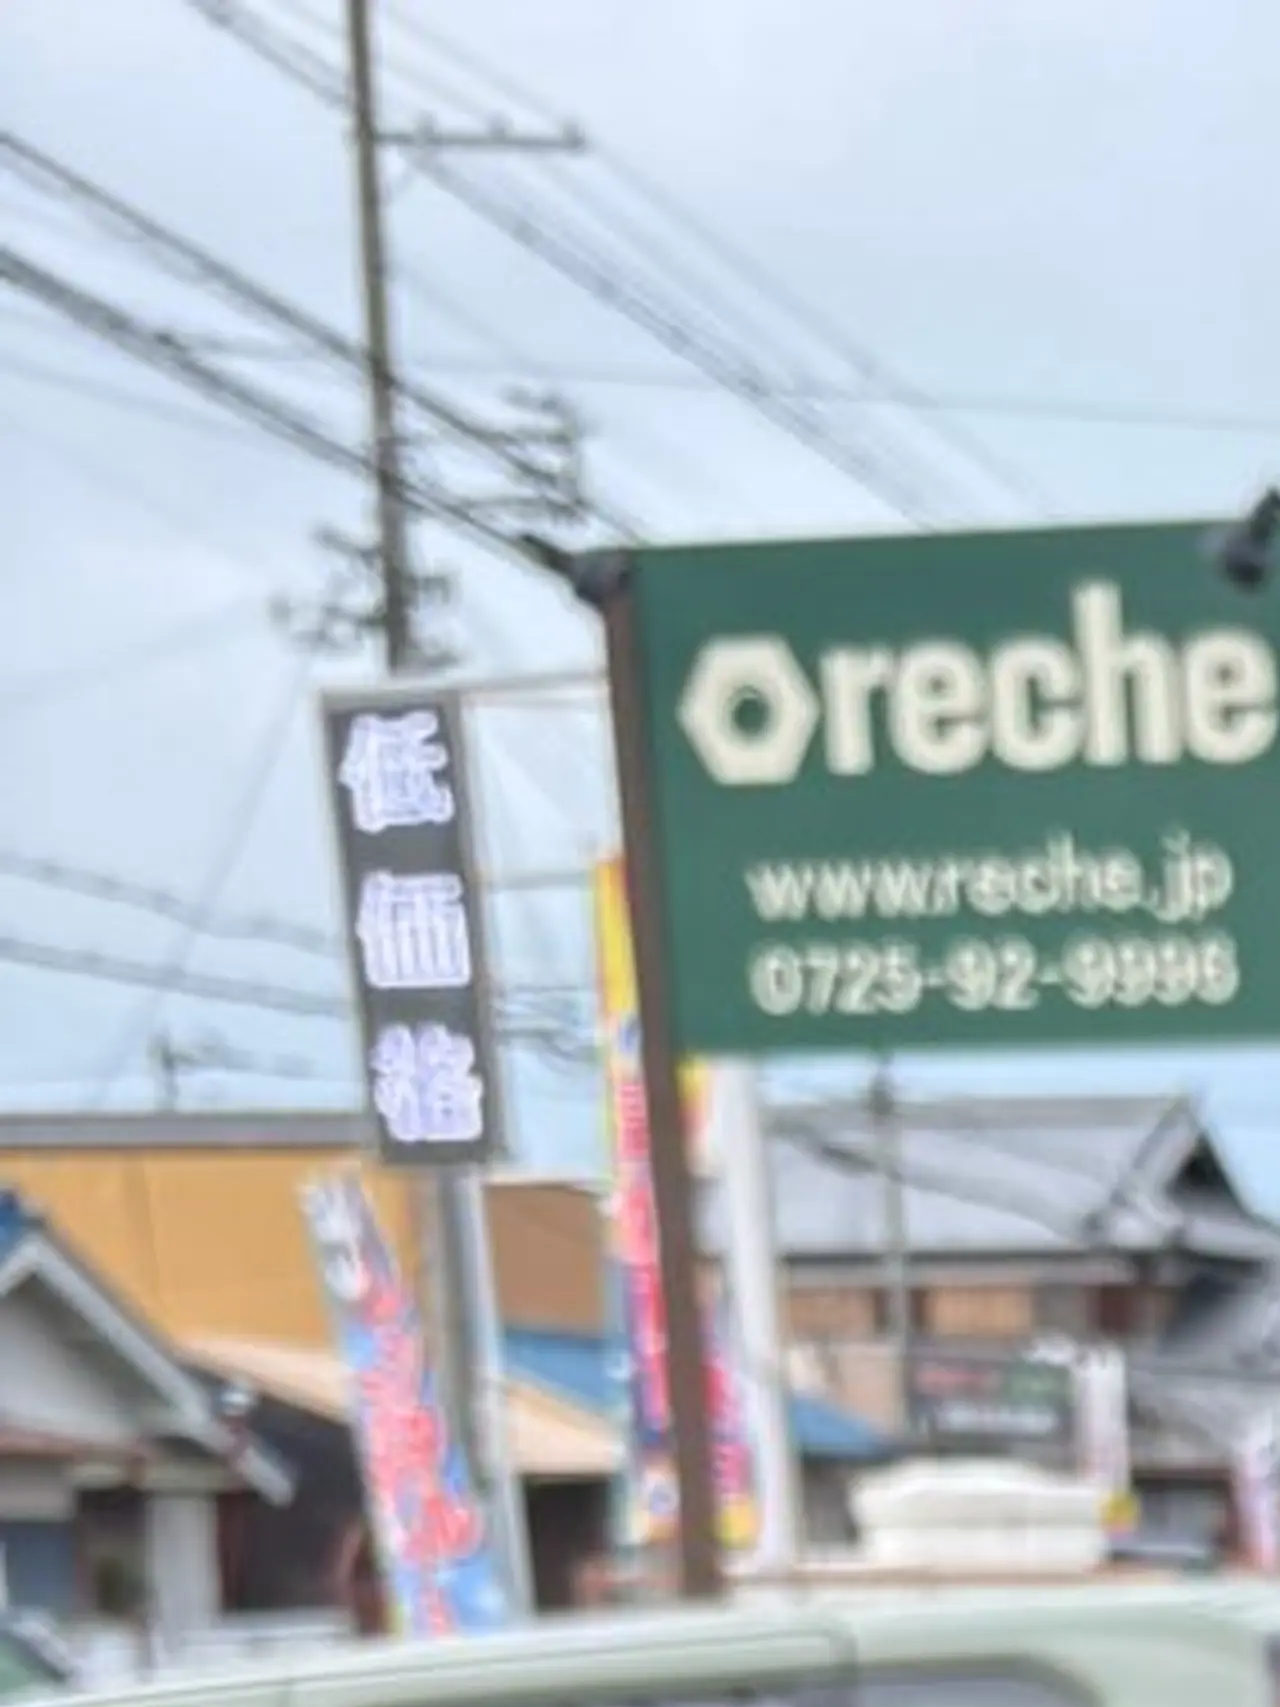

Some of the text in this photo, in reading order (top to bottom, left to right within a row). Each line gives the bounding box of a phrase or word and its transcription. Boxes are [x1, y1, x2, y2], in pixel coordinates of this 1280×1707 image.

[821, 580, 1278, 774] reche
[340, 710, 484, 1140] 低価格
[748, 830, 1234, 920] www.reche.jp
